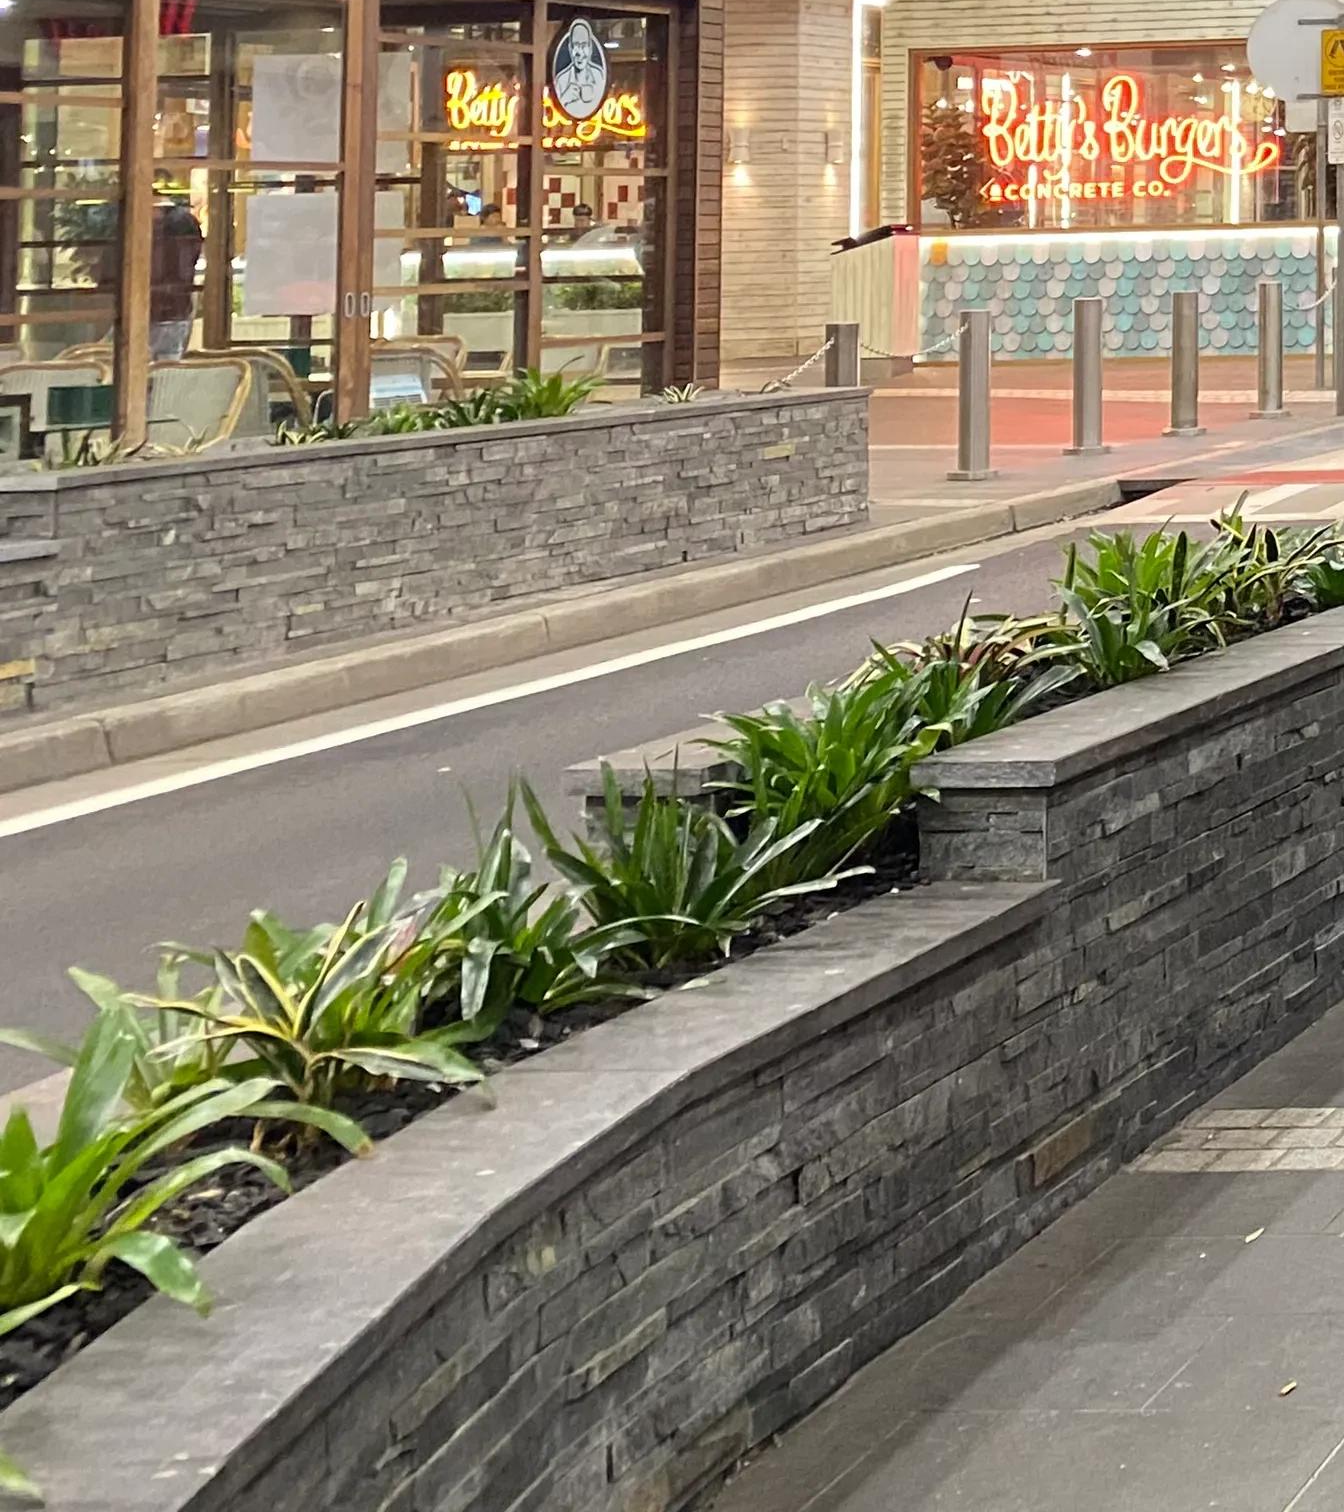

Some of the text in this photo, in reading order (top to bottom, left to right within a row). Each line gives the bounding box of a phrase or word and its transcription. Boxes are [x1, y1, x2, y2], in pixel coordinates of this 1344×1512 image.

[981, 76, 1100, 181] Betty's
[1102, 75, 1278, 184] Burgers
[1004, 181, 1125, 201] CONCRETE
[1132, 179, 1171, 198] CO.
